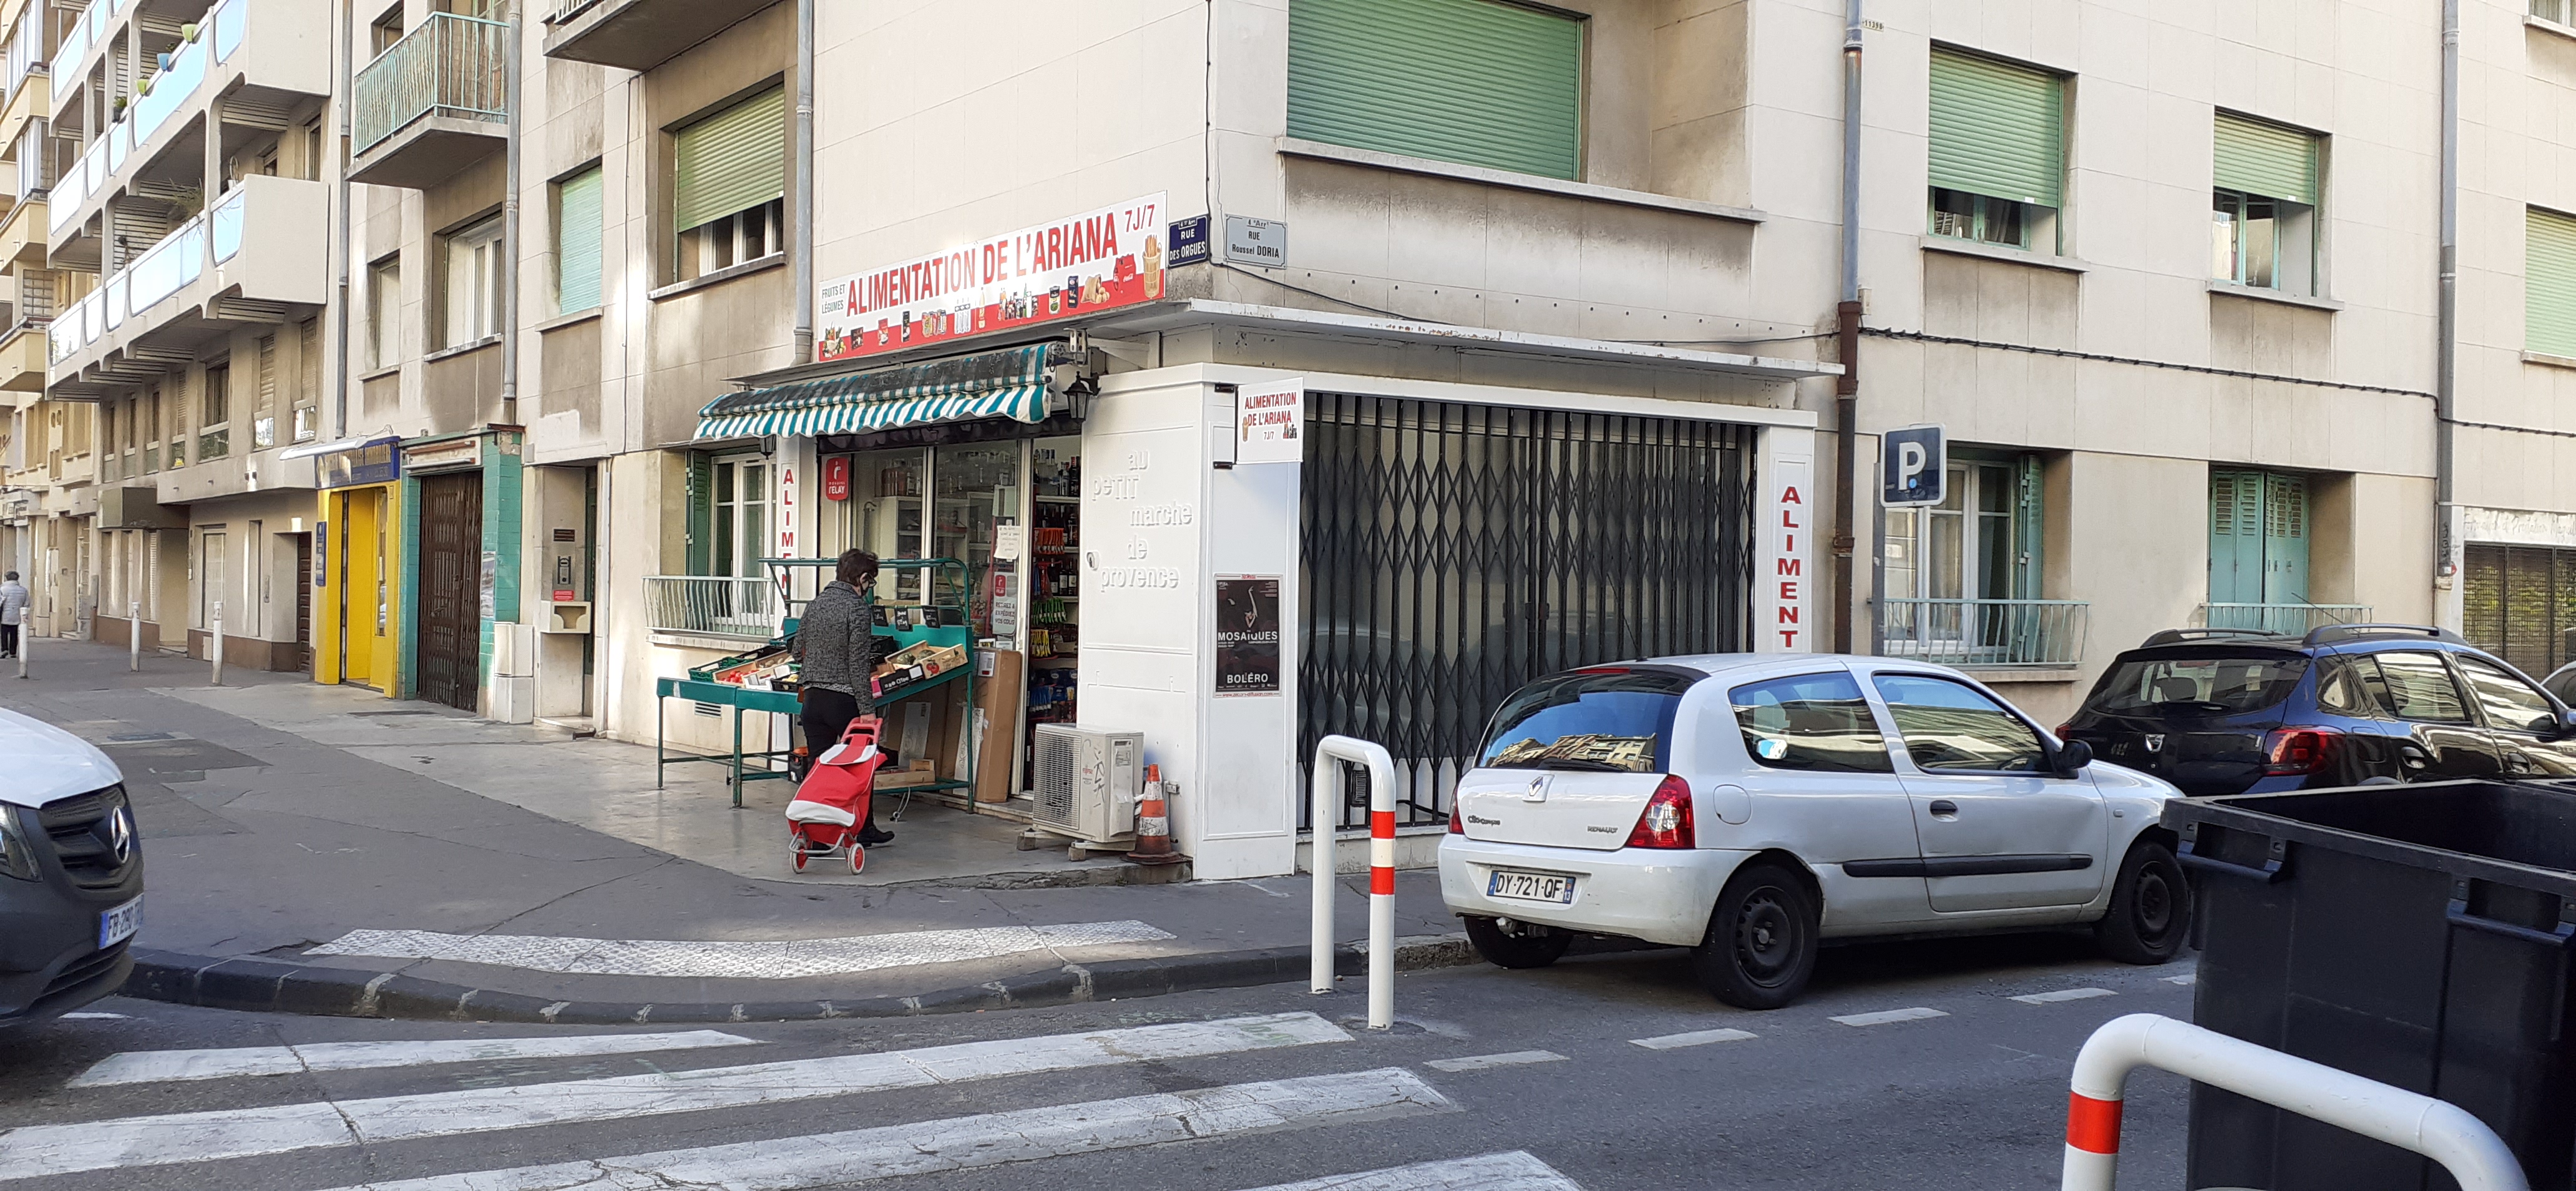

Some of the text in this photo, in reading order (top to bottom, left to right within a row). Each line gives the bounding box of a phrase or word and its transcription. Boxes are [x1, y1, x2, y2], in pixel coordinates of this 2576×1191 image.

[1181, 228, 1195, 240] RUE
[1248, 230, 1261, 241] RUE
[1169, 241, 1206, 261] DES ORGUES
[1232, 243, 1280, 258] Roussel DORIA
[846, 204, 1155, 317] ALIMENTATION DE L'ARIANA 7J/7
[822, 283, 846, 300] FRUITS ET
[822, 300, 844, 314] LÉGUMES
[1244, 391, 1297, 409] ALIMENTATION
[1247, 409, 1292, 426] DE L'ARIANA
[1264, 431, 1274, 440] 7J/7
[1128, 451, 1149, 471] au
[1898, 441, 1926, 491] P
[1128, 534, 1148, 560] de
[1777, 486, 1802, 648] ALIMENT
[1100, 567, 1179, 593] provence
[1227, 672, 1269, 684] BOLÉRO
[1587, 825, 1619, 833] RENAULT
[1564, 891, 1571, 901] 13
